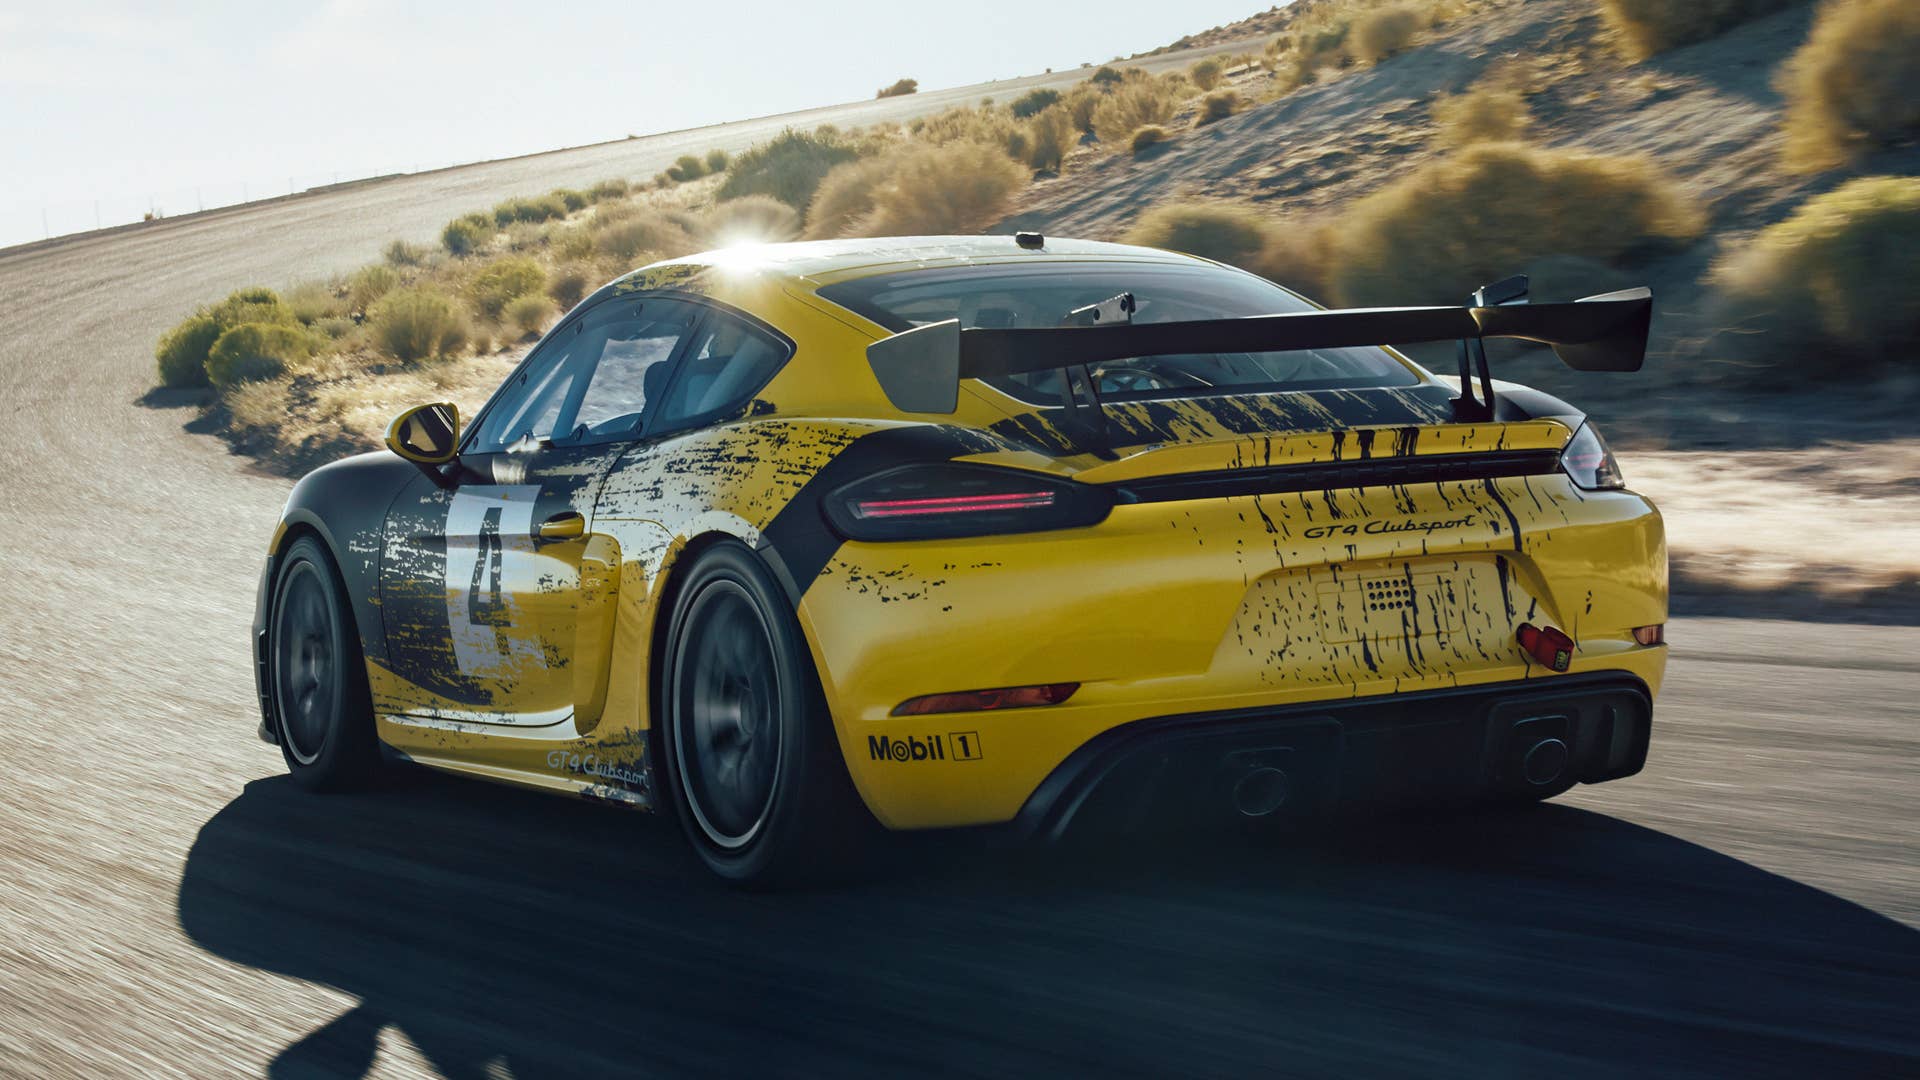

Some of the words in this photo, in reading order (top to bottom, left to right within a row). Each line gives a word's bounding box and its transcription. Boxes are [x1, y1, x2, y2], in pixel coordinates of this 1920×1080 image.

[1304, 524, 1358, 539] GT4
[1364, 515, 1476, 535] Clubsport
[468, 507, 512, 656] 4
[547, 751, 579, 771] GT4
[868, 735, 945, 762] Mobil
